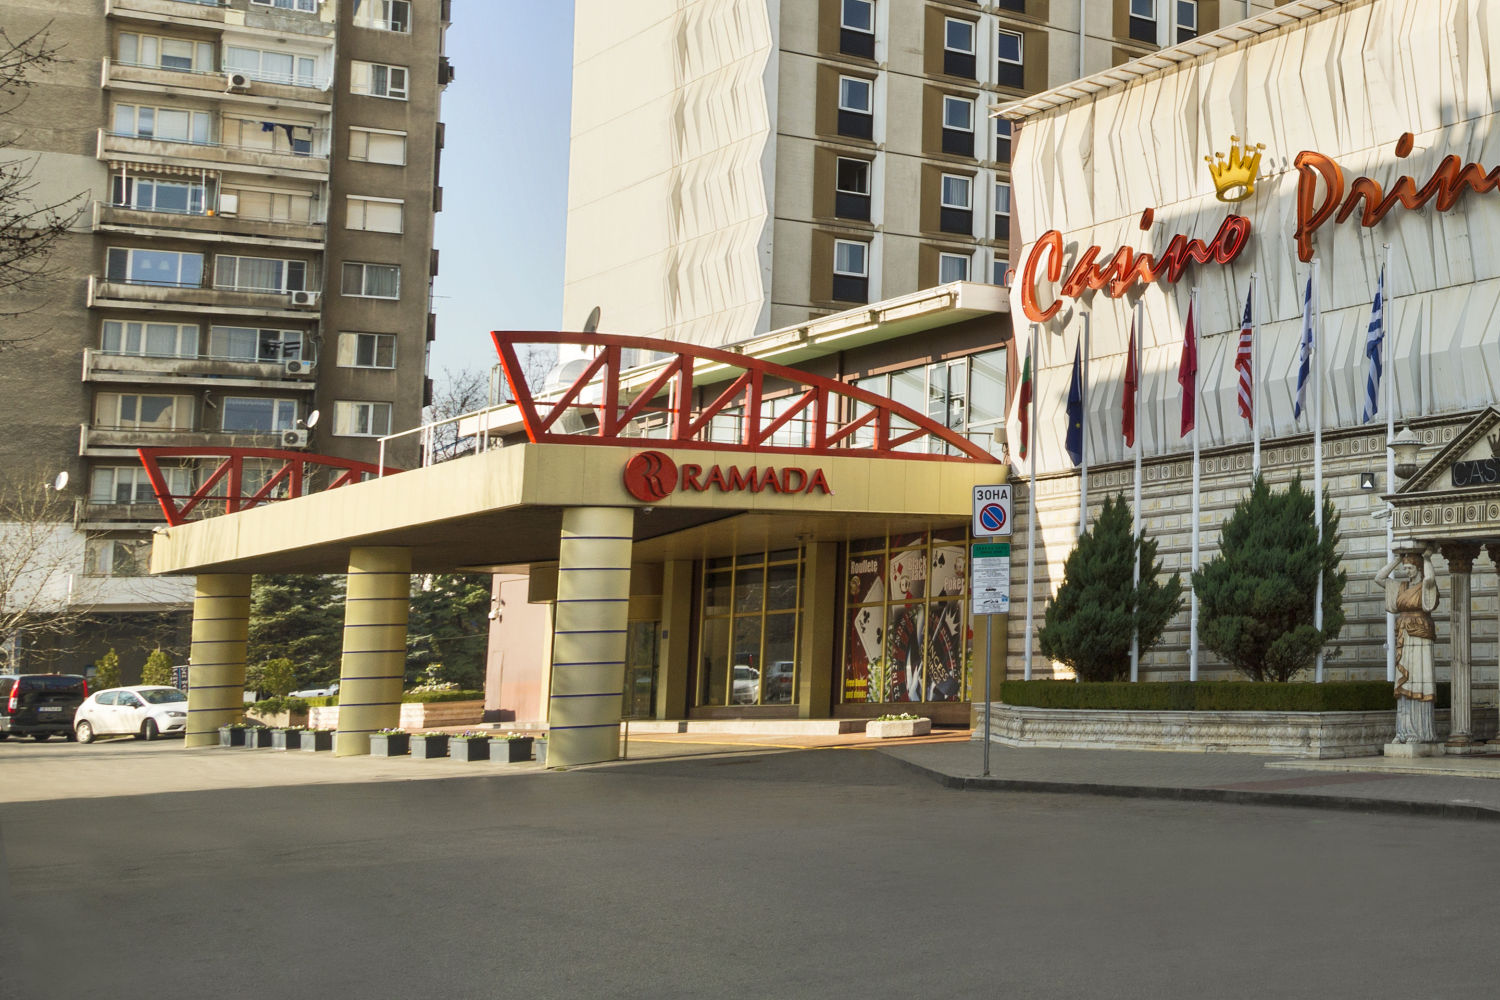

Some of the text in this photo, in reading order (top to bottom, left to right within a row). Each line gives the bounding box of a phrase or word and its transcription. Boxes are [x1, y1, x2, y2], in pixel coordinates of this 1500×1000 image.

[1021, 207, 1251, 323] Casino
[682, 464, 831, 495] RAMADA
[977, 489, 1008, 500] ЗОНА
